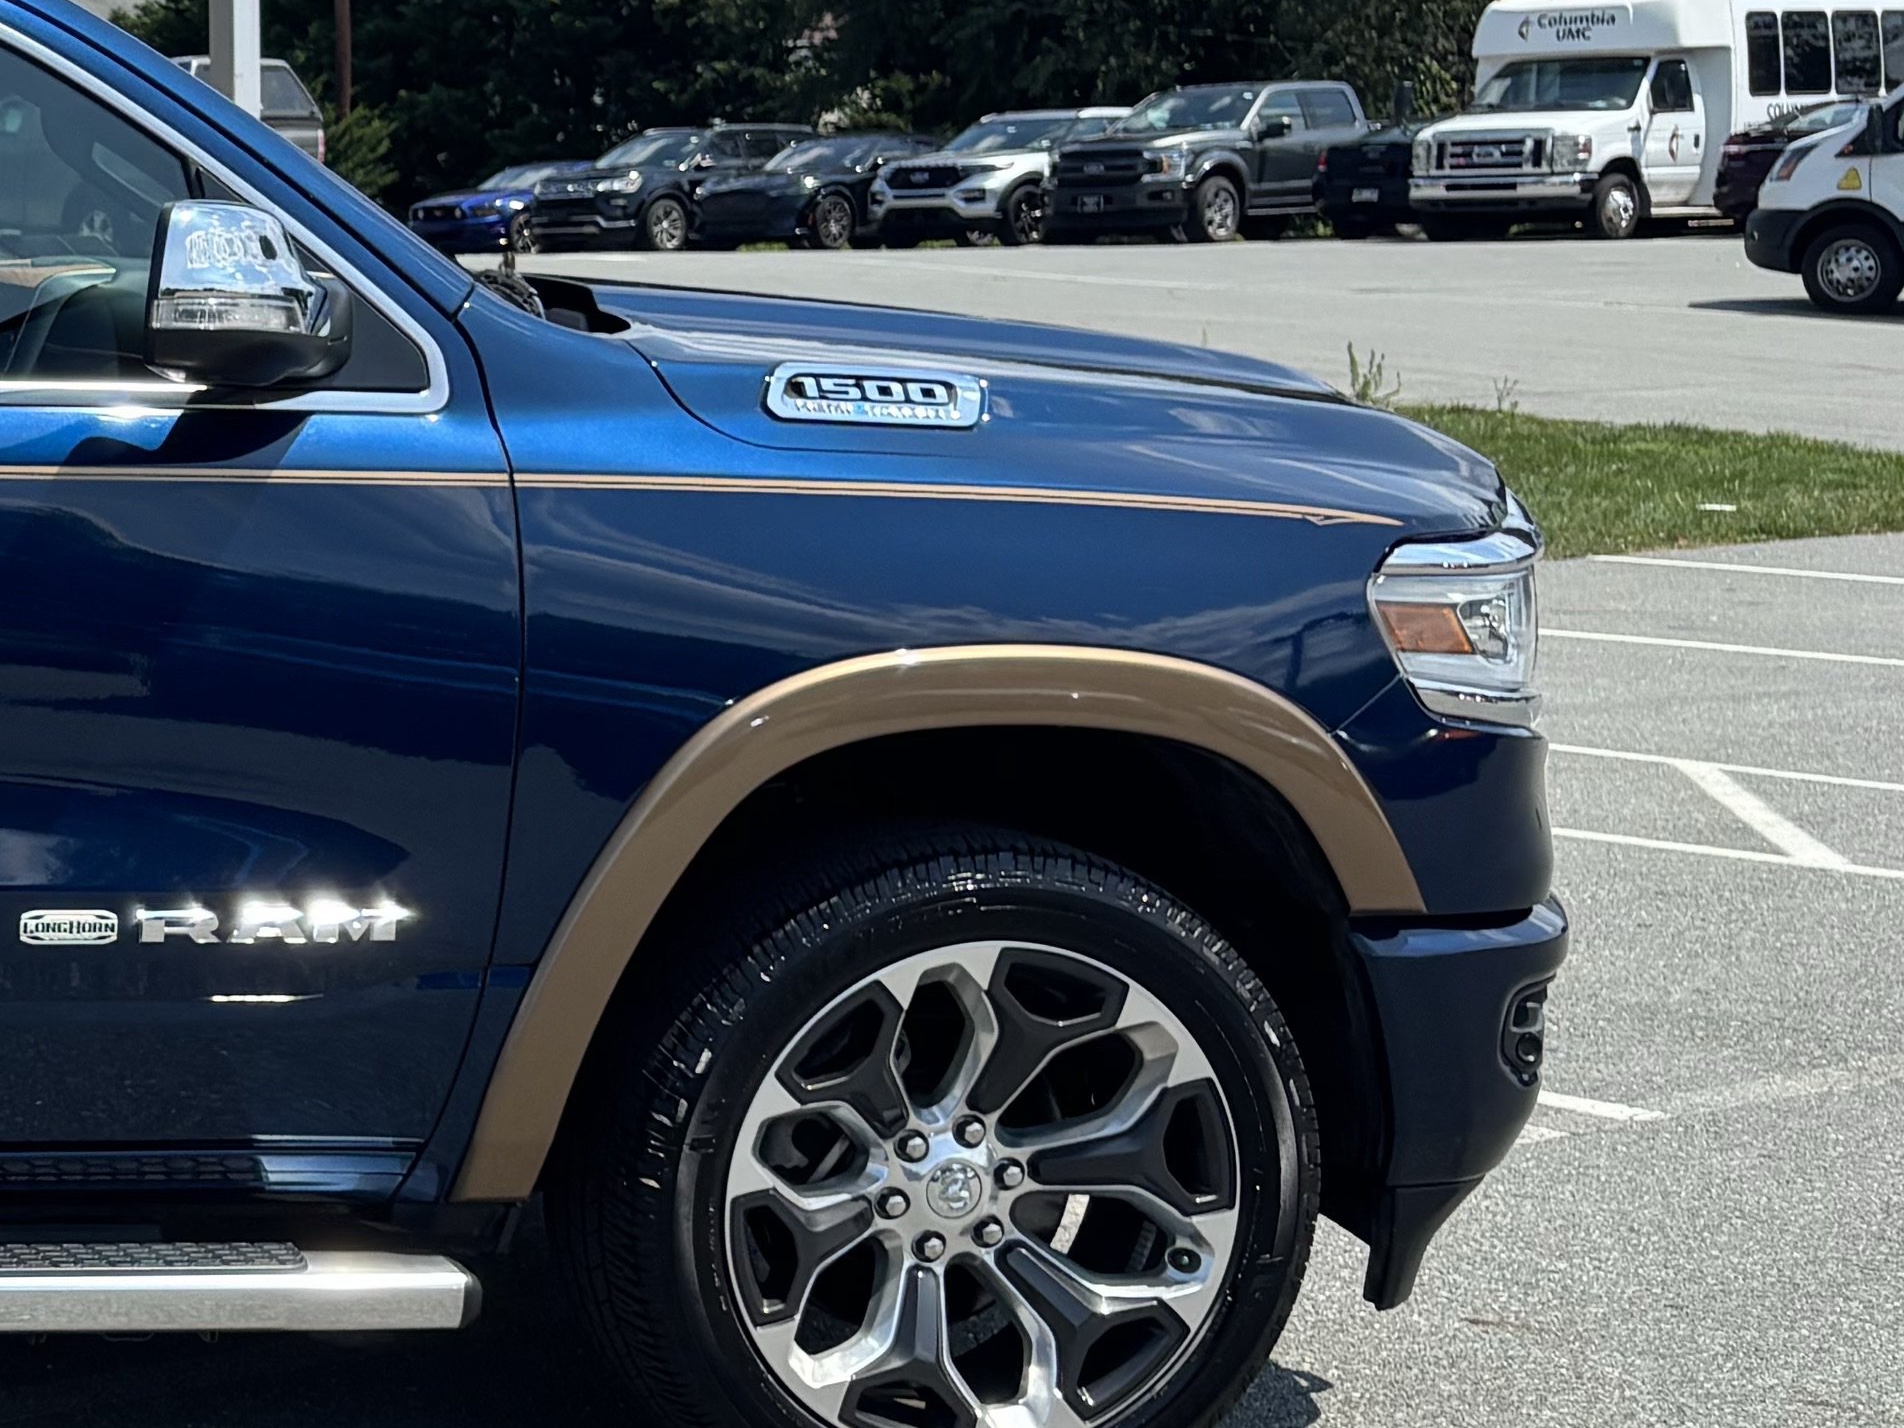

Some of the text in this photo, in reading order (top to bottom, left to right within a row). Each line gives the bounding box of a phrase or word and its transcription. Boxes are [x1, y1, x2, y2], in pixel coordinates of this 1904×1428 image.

[1537, 10, 1616, 29] Columbia
[1556, 27, 1593, 42] UMC
[792, 376, 950, 405] 1500
[22, 903, 406, 944] LONGHORN RAM
